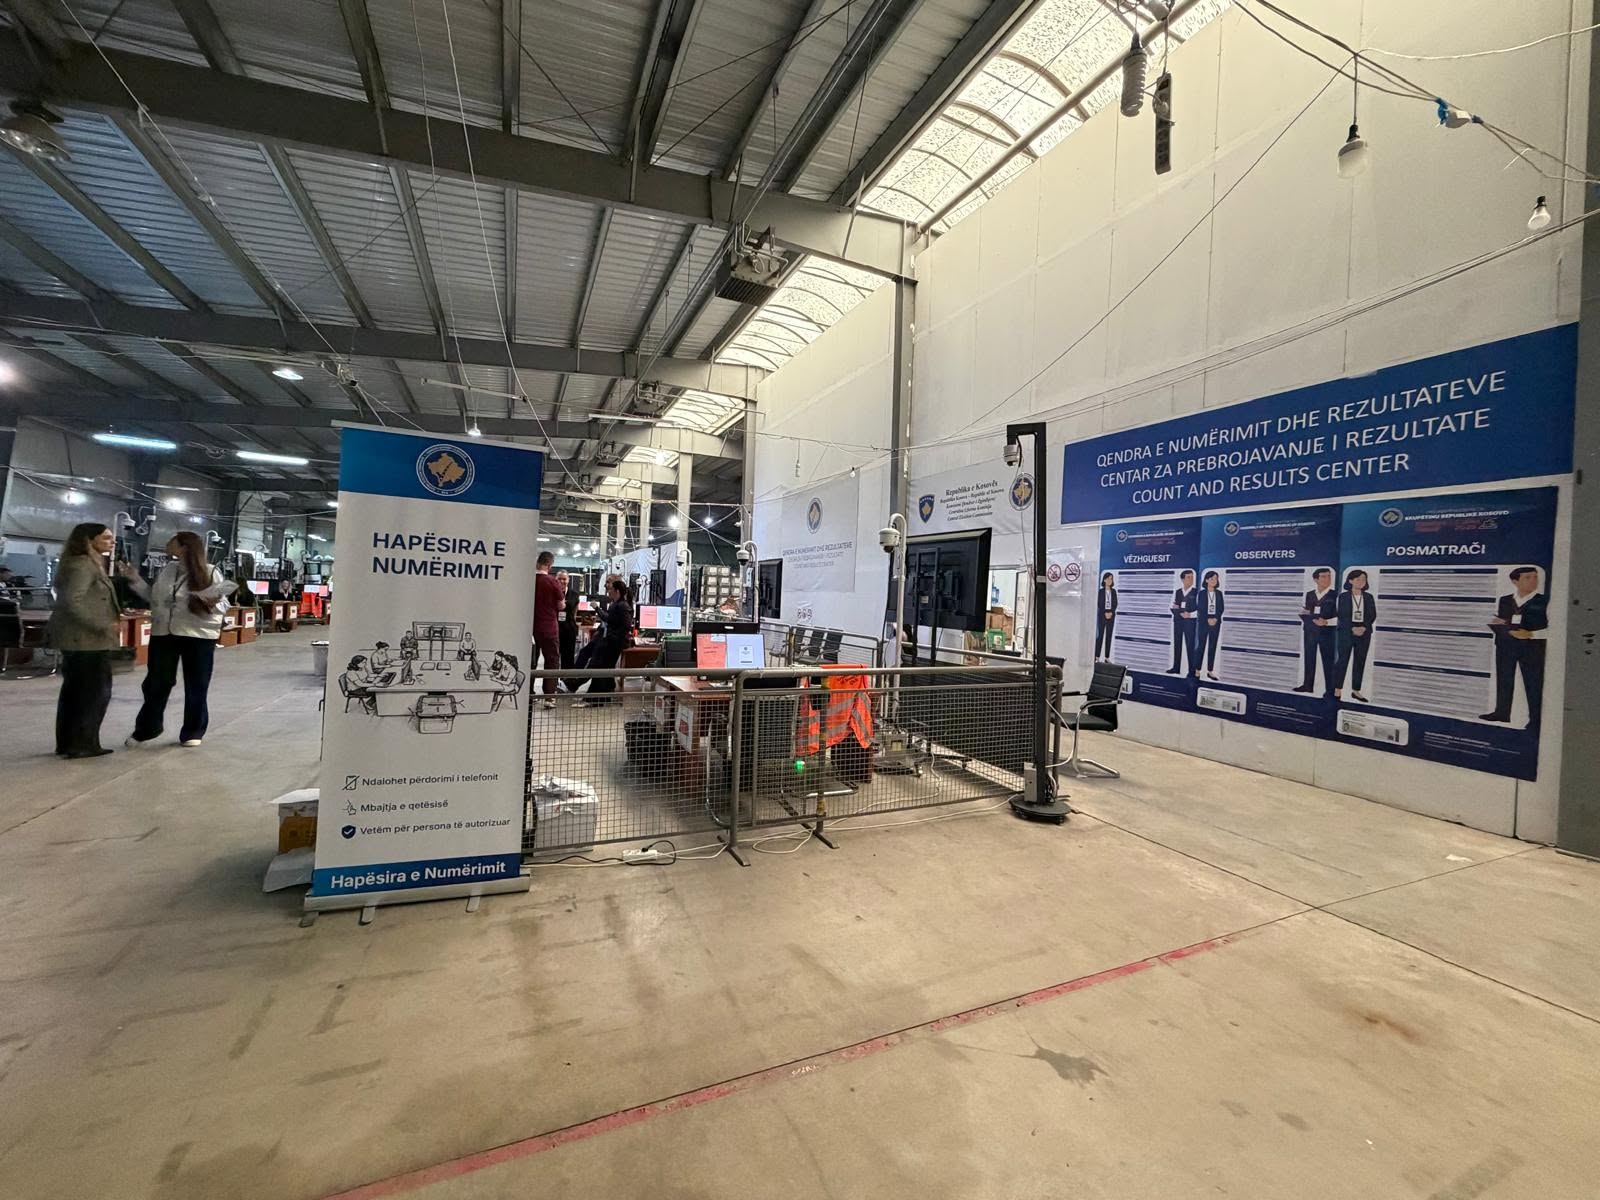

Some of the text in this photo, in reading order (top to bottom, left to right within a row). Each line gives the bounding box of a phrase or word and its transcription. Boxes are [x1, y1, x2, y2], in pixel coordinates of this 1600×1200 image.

[1097, 370, 1506, 468] QENDRA E NUMËRIMIT DHE REZULTATEVE
[1101, 408, 1491, 488] CENTAR ZA PREBROJAVANJE I REZULTATE
[1132, 453, 1410, 505] COUNT AND RESULTS CENTER
[372, 532, 506, 557] HAPËSIRA E
[1234, 549, 1296, 560] OBSERVERS
[1386, 541, 1486, 556] POSMATRAČI
[372, 556, 504, 580] NUMËRIMIT
[362, 776, 407, 786] Ndalohet
[409, 774, 456, 785] përdorimi
[461, 773, 499, 782] telefonit
[360, 802, 397, 814] Mbajtja
[408, 800, 449, 811] qetësisë
[360, 818, 511, 835] Vetëm për persona të autorizuar
[331, 861, 506, 889] Hapësira e Numërimit
